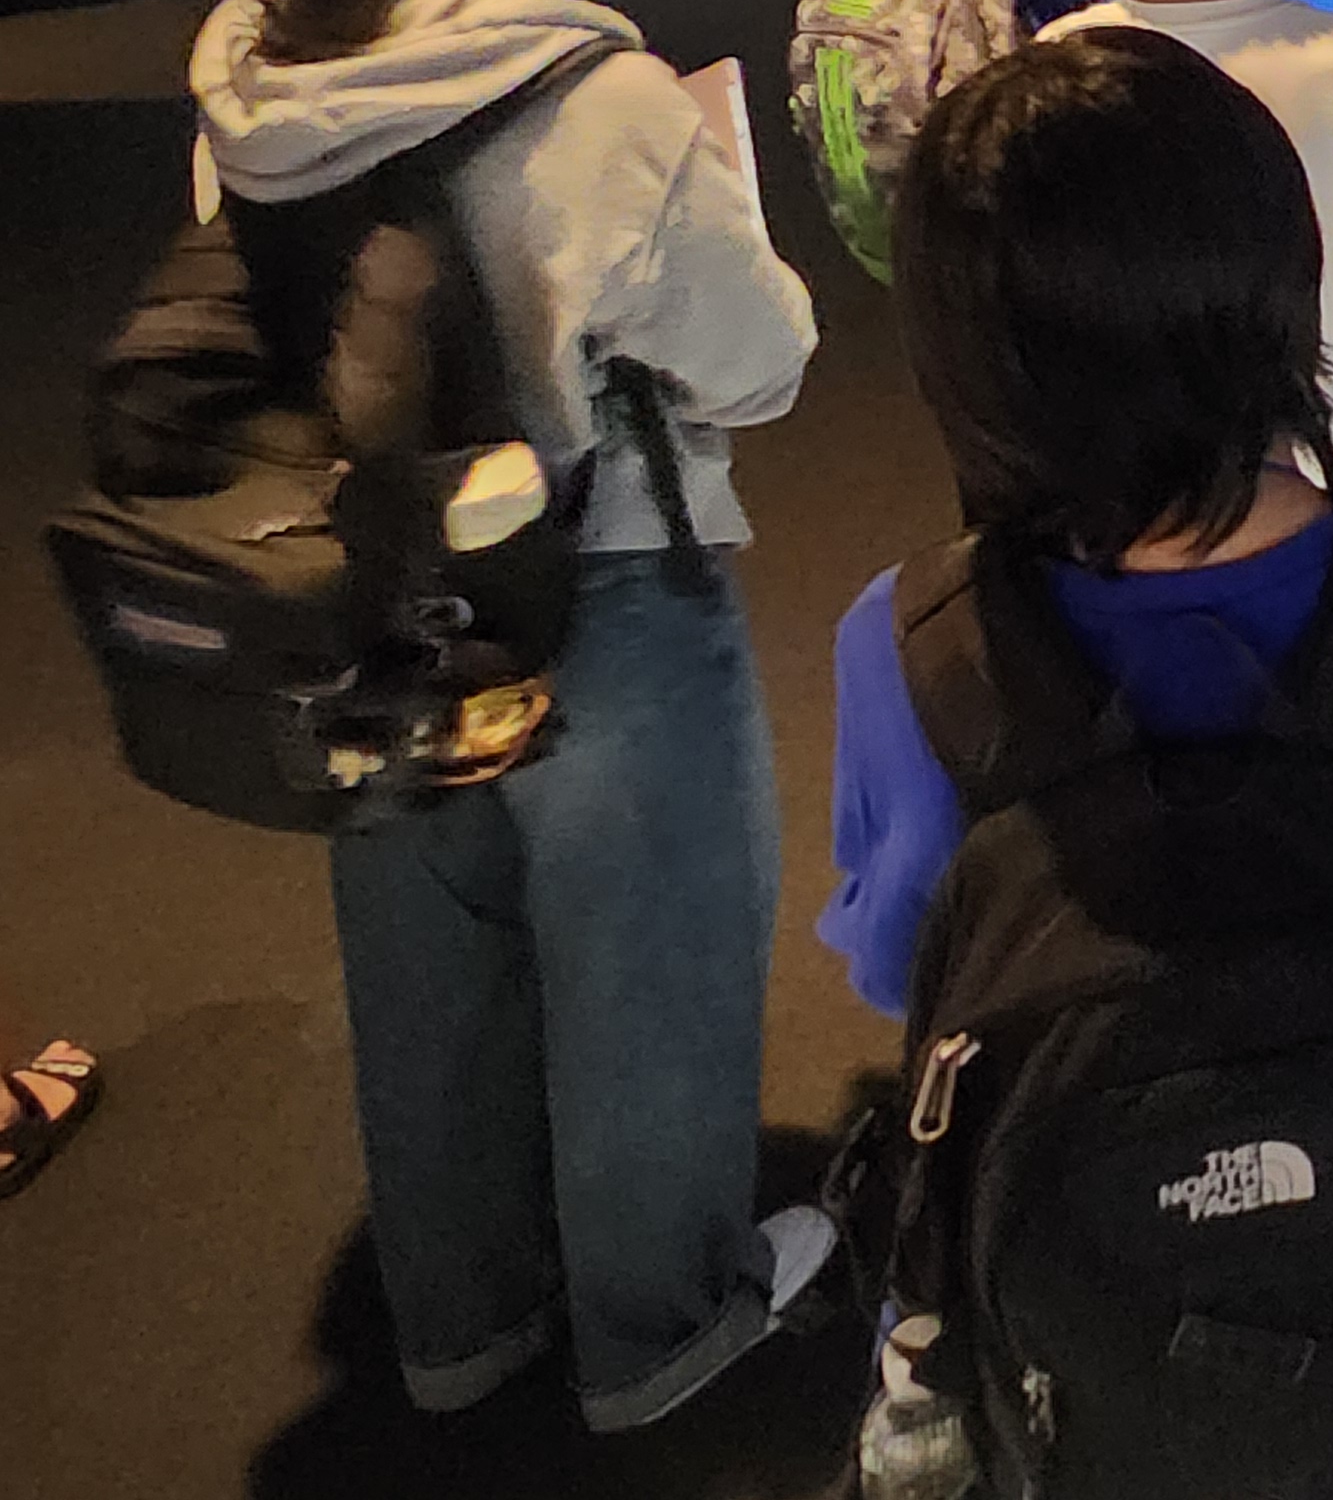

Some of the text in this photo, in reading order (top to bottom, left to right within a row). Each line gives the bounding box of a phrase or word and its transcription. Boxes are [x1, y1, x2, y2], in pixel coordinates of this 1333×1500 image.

[1203, 1142, 1259, 1173] THE
[1159, 1162, 1259, 1210] NORTH
[1189, 1187, 1261, 1222] FACE
